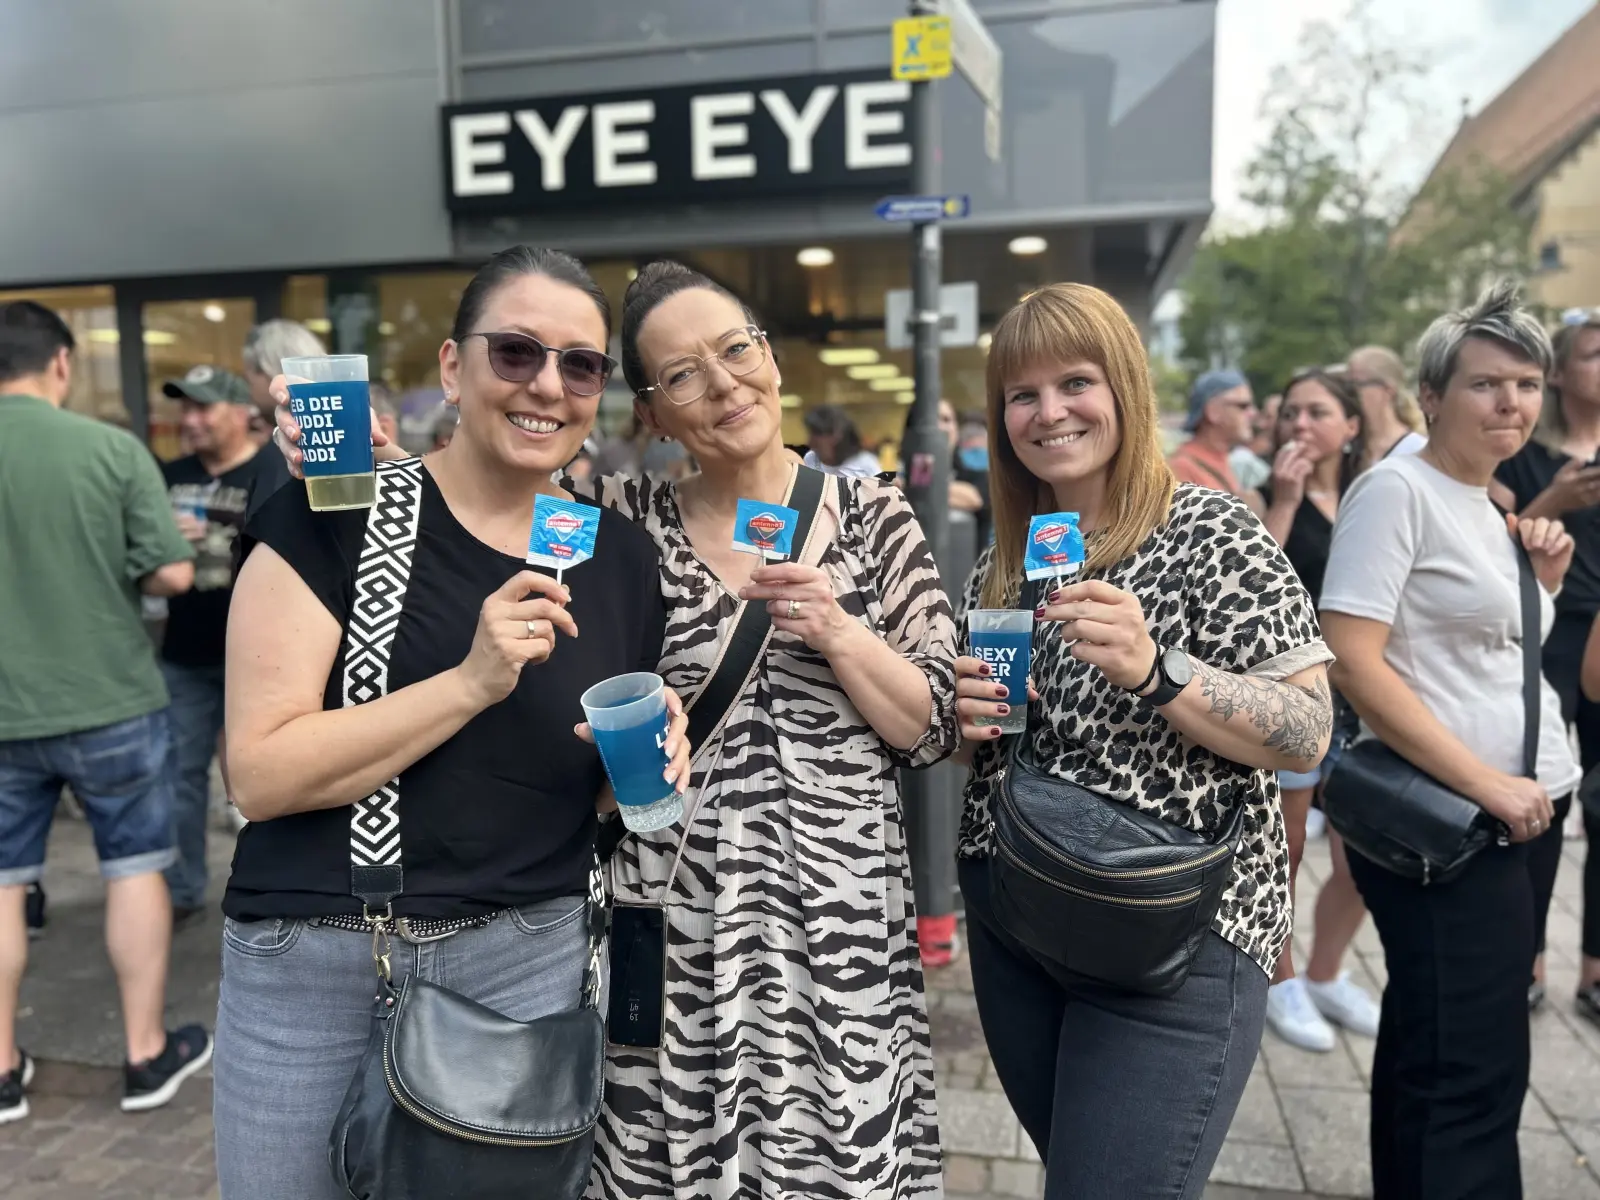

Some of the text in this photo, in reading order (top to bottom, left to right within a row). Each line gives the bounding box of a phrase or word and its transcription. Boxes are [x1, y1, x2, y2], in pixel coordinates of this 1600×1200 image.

[450, 79, 912, 197] EYE EYE
[291, 395, 344, 413] EB DIE
[295, 413, 334, 430] UDDI
[311, 429, 345, 446] AUF
[302, 447, 337, 463] ADDI
[974, 647, 1018, 662] SEXY
[990, 662, 1011, 677] ER
